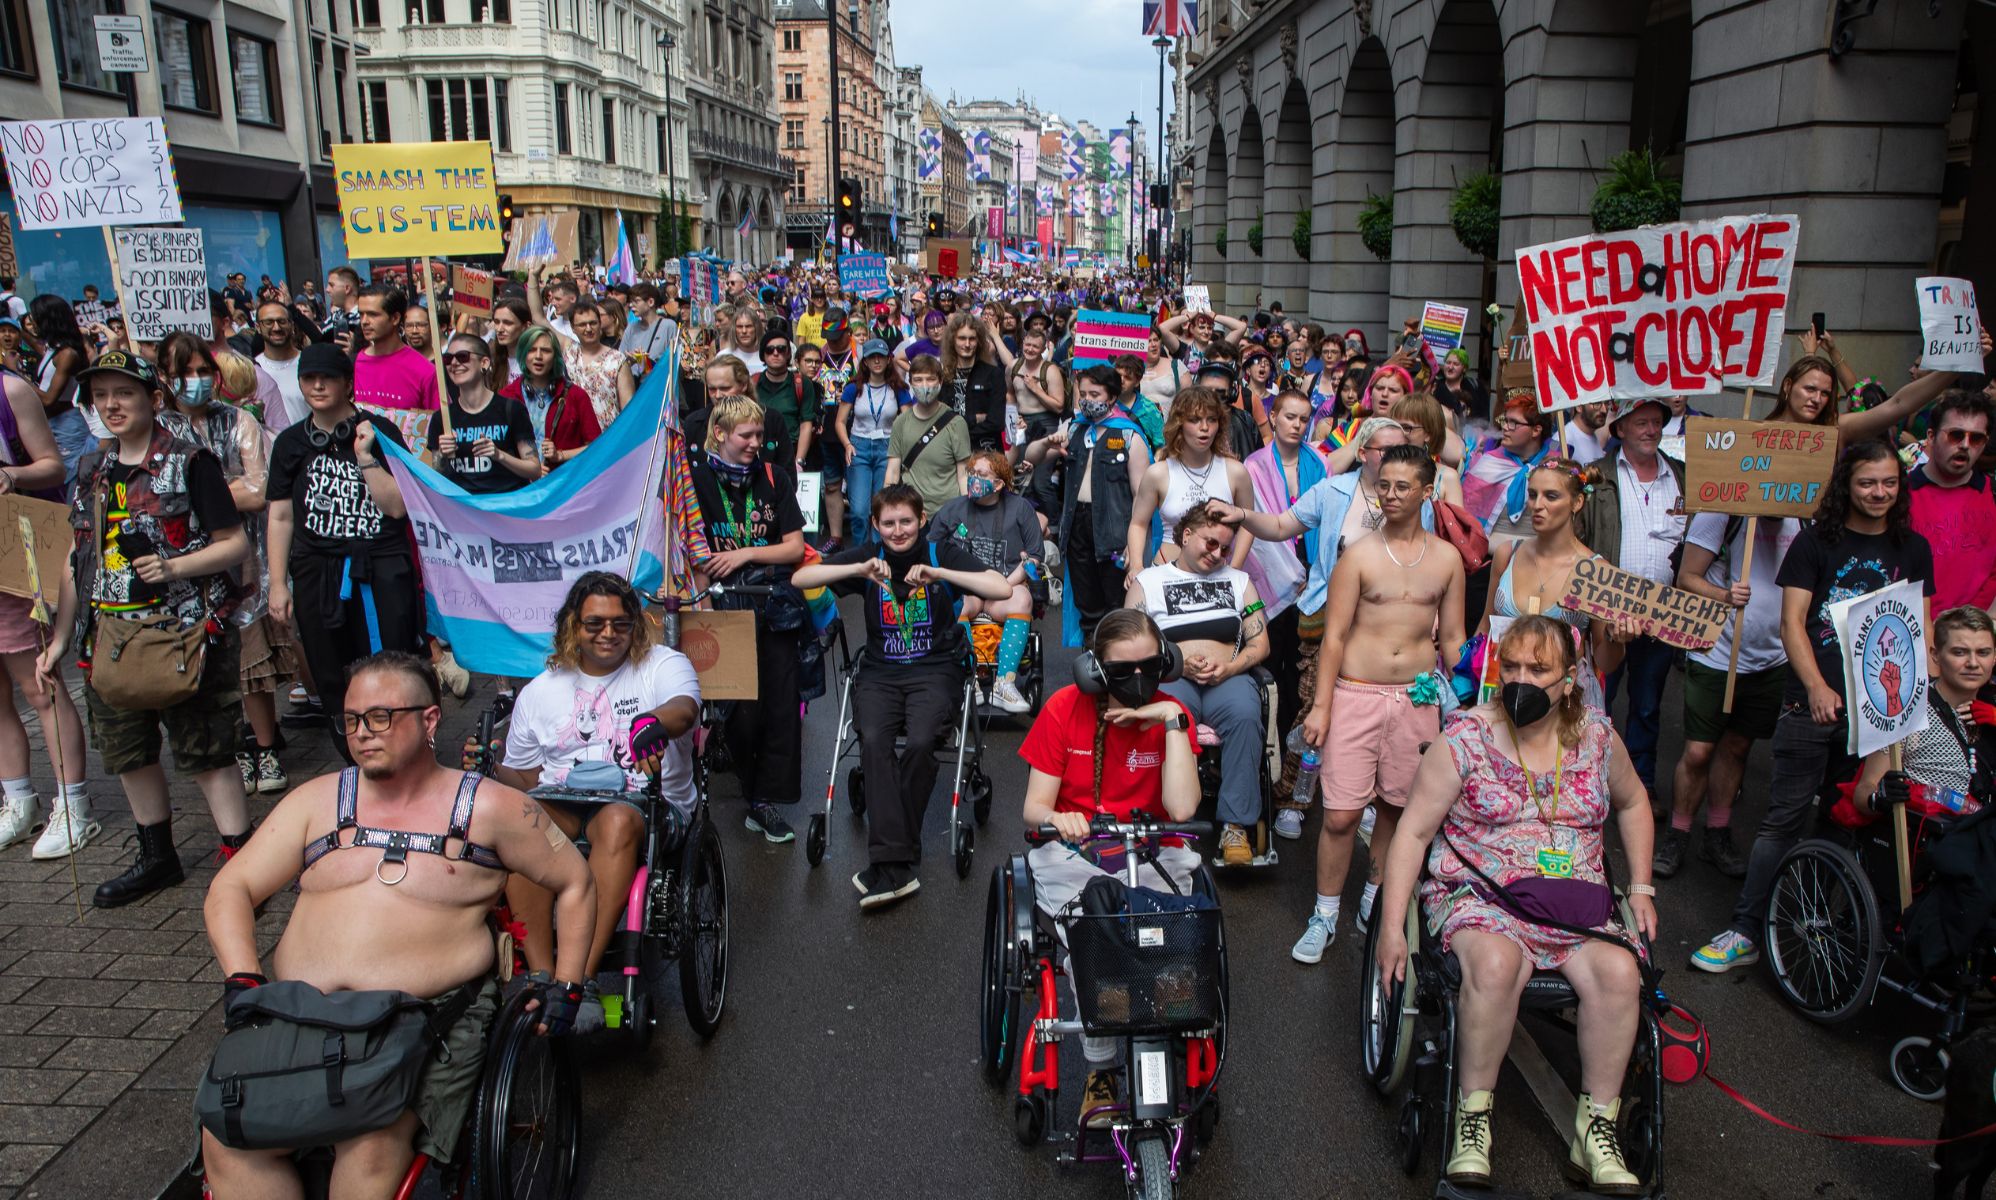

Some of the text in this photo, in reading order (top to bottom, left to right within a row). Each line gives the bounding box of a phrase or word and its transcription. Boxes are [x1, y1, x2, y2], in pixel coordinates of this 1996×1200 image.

[1, 119, 127, 155] NO TERFS
[145, 120, 160, 142] 1
[148, 145, 164, 164] 3
[10, 154, 121, 189] NO COPS
[154, 165, 169, 188] 1
[340, 167, 487, 192] SMASH THE
[17, 184, 143, 224] NO NAZIS
[158, 188, 173, 209] 2
[349, 203, 496, 234] CIS-TEM
[163, 231, 199, 247] BINARY
[133, 247, 203, 265] IS DATED!
[169, 269, 206, 288] BINARY
[850, 279, 879, 290] TOUR
[1519, 221, 1790, 324] NEED a HOME
[465, 281, 474, 294] IS
[1925, 285, 1975, 309] TRANS
[74, 300, 105, 314] THE
[135, 288, 207, 314] IS SIMPLY
[131, 311, 161, 325] OUR
[192, 322, 211, 338] DAY
[1086, 318, 1143, 333] stay strong
[1954, 315, 1972, 335] IS
[1080, 335, 1145, 350] trans friends
[1533, 293, 1786, 408] NOT a CLOSET
[1705, 428, 1825, 453] NO TERFS
[312, 453, 358, 480] MAKE
[1740, 455, 1772, 472] ON
[309, 472, 360, 499] SPACE
[1698, 480, 1822, 505] OUR TURF
[305, 512, 380, 538] QUEERS
[1575, 558, 1731, 626] QUEER RIGHTS
[1570, 577, 1708, 639] STARTED WITH
[1588, 602, 1655, 635] TRAS
[1854, 599, 1922, 658] TRANS ACTION FOR
[883, 638, 933, 654] PROECT
[614, 697, 639, 710] Atistic
[1860, 677, 1926, 732] HOUSING JUSTICE
